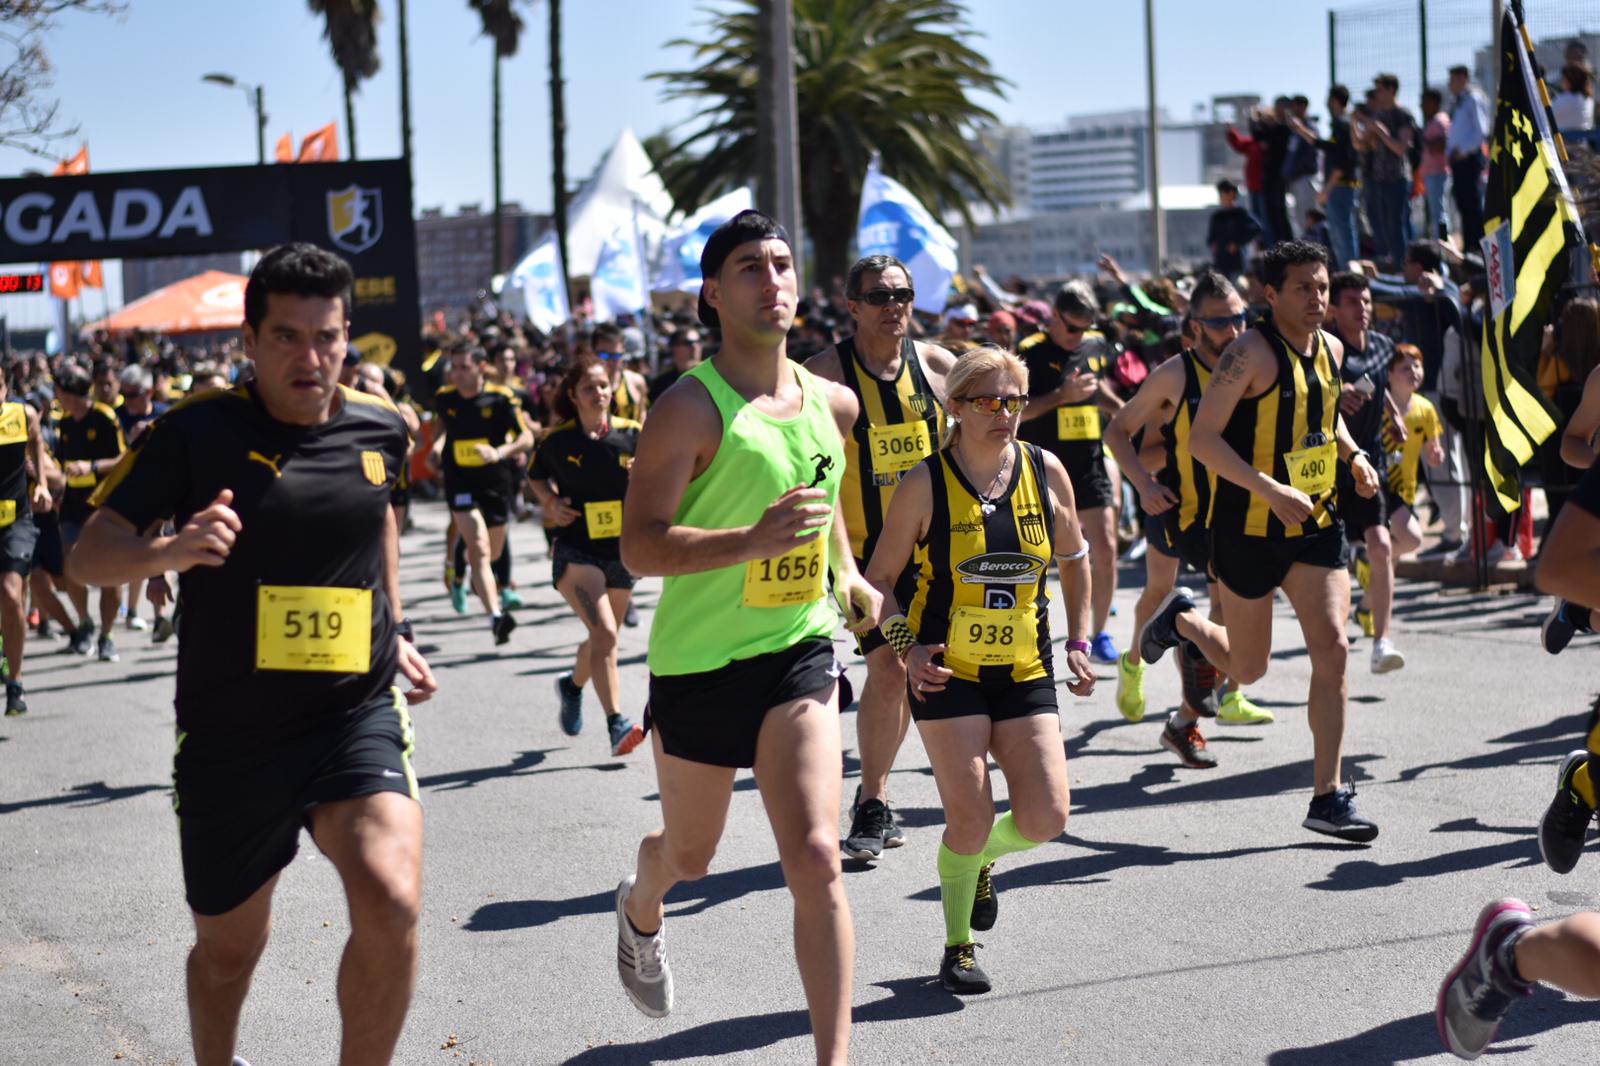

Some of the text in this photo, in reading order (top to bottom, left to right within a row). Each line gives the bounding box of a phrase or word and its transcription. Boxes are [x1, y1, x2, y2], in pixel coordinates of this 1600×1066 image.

[0, 185, 213, 246] GADA
[878, 435, 925, 456] 3066
[1301, 459, 1326, 479] 490
[597, 511, 614, 525] 15
[760, 553, 819, 582] 1656
[979, 561, 1030, 571] Berocca
[284, 610, 342, 639] 519
[969, 623, 1013, 645] 938
